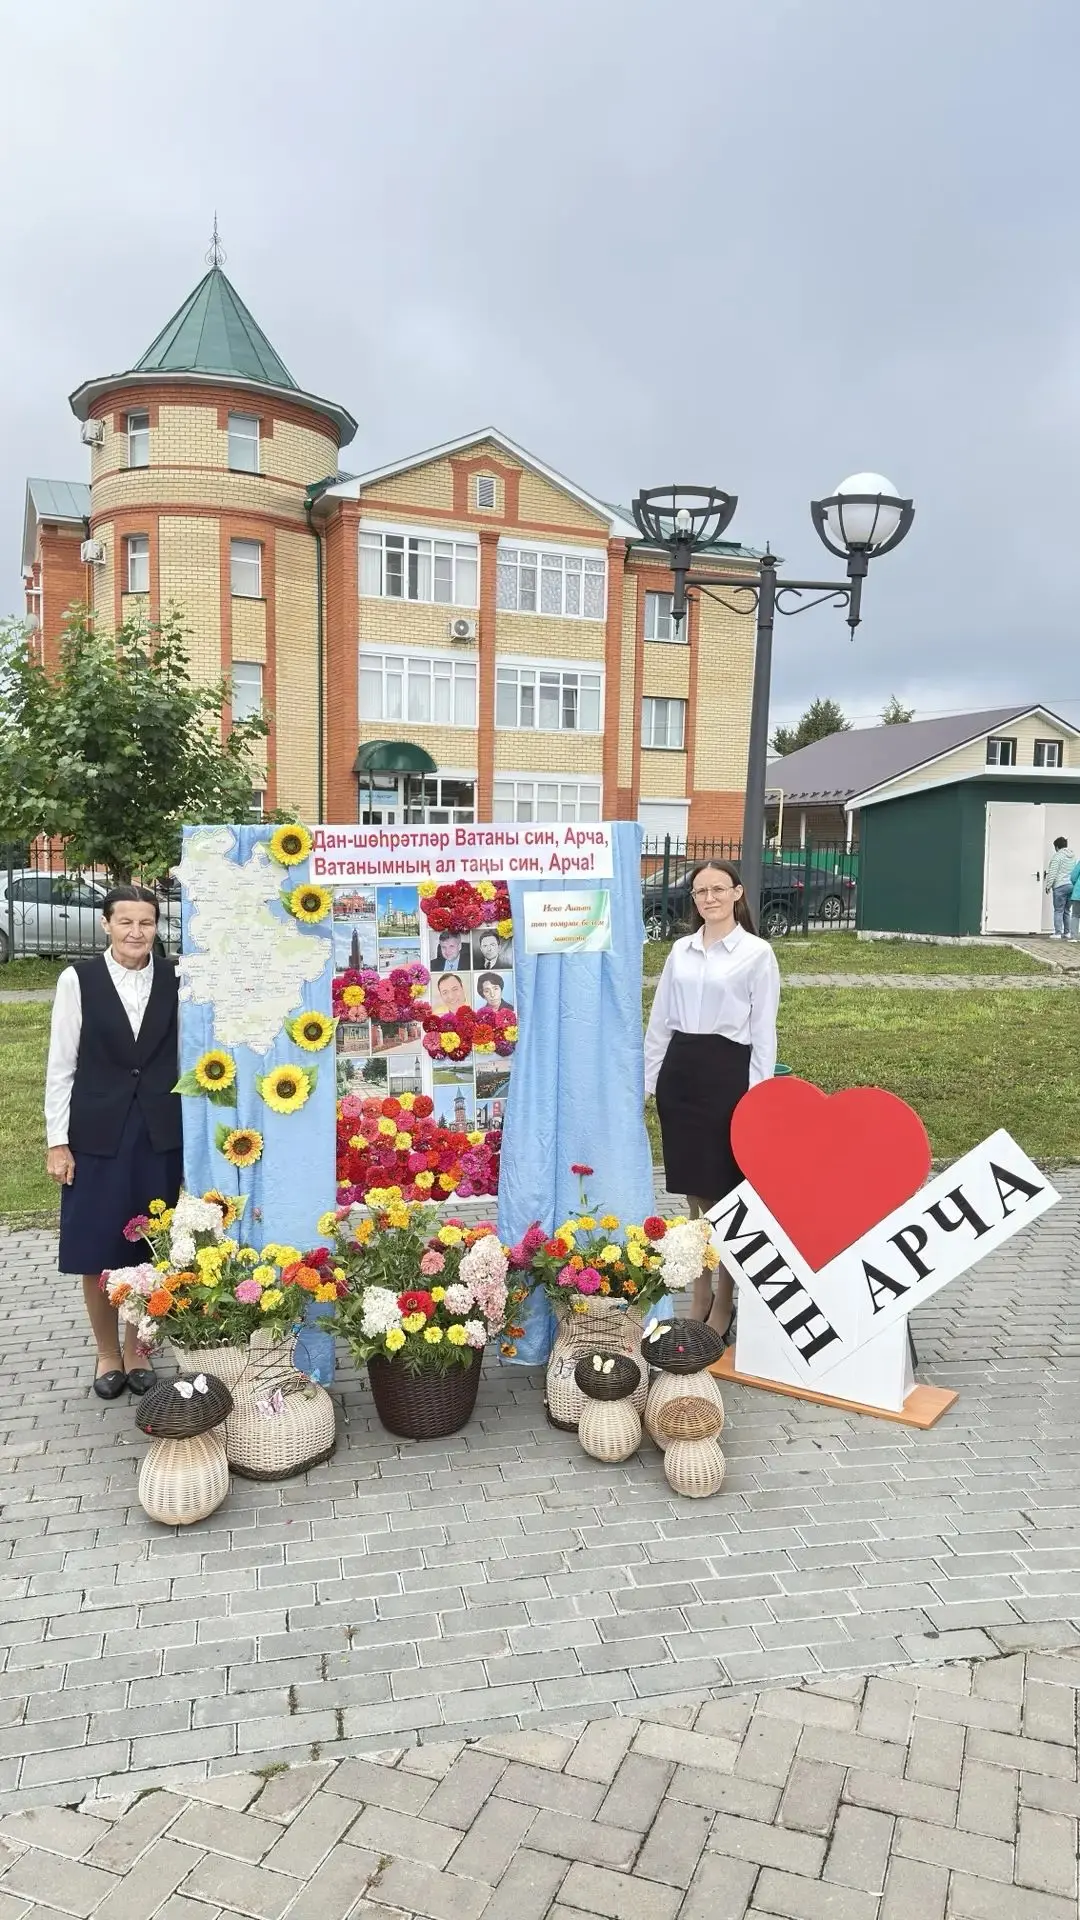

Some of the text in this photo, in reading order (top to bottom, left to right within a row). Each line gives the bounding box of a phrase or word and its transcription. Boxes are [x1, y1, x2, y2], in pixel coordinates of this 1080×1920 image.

[313, 827, 609, 852] Дан-шөһрәтләр Ватаны син, Арча,
[314, 852, 595, 876] Ватанымның ал таңы син, Арча!
[711, 1194, 843, 1367] МИН
[861, 1160, 1045, 1315] АРЧА
